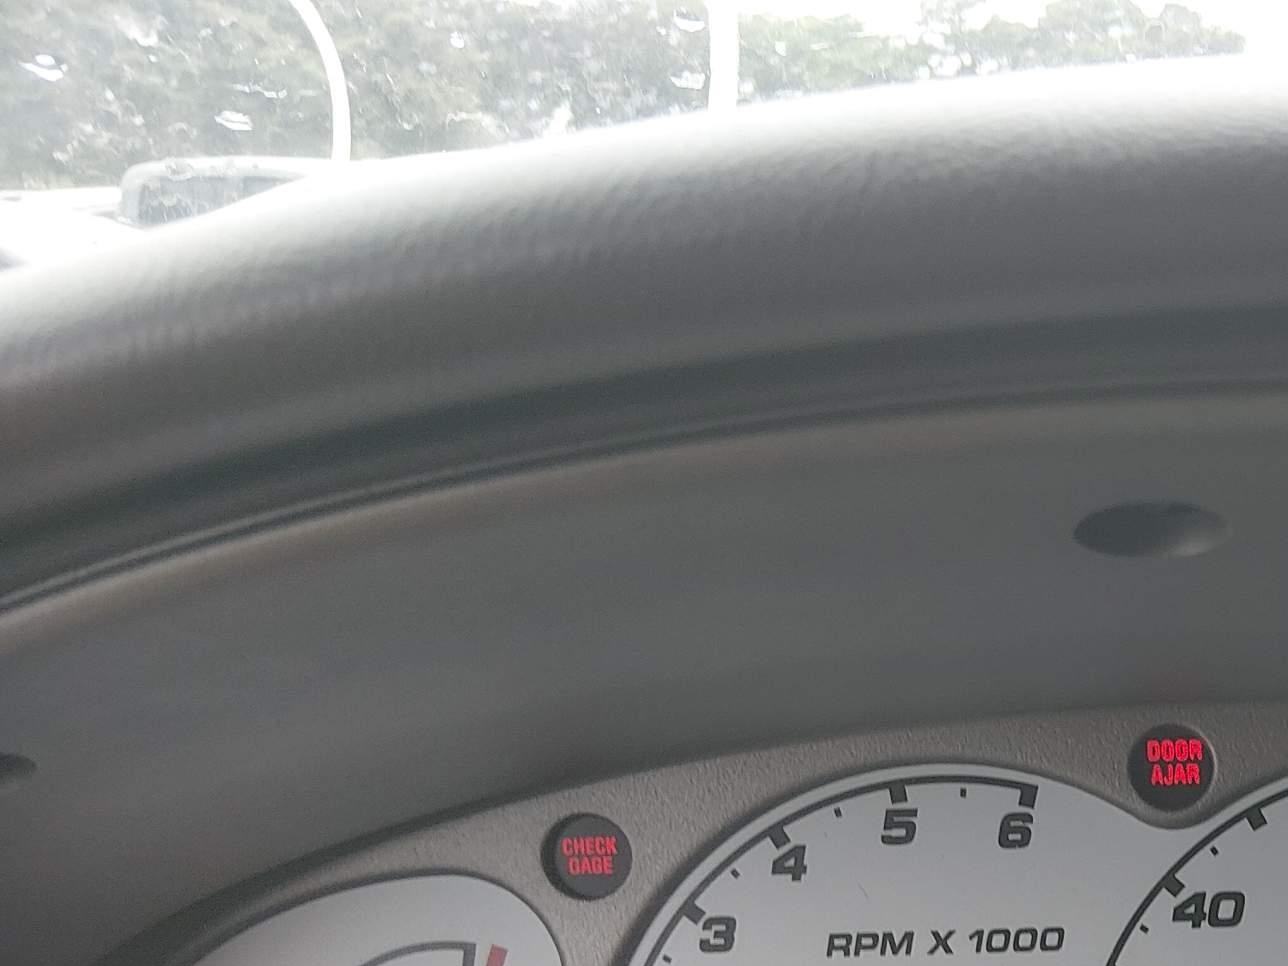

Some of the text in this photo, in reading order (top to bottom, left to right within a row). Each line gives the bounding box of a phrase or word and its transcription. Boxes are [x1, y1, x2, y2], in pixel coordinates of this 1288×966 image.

[1146, 738, 1204, 763] DOOR
[1149, 763, 1201, 786] AJAR
[880, 808, 918, 845] 5
[998, 812, 1033, 849] 6
[561, 835, 618, 856] CHECK
[771, 845, 808, 881] 4
[1171, 891, 1246, 928] 40
[699, 916, 737, 952] 3
[826, 926, 1065, 958] RPM X 1000
